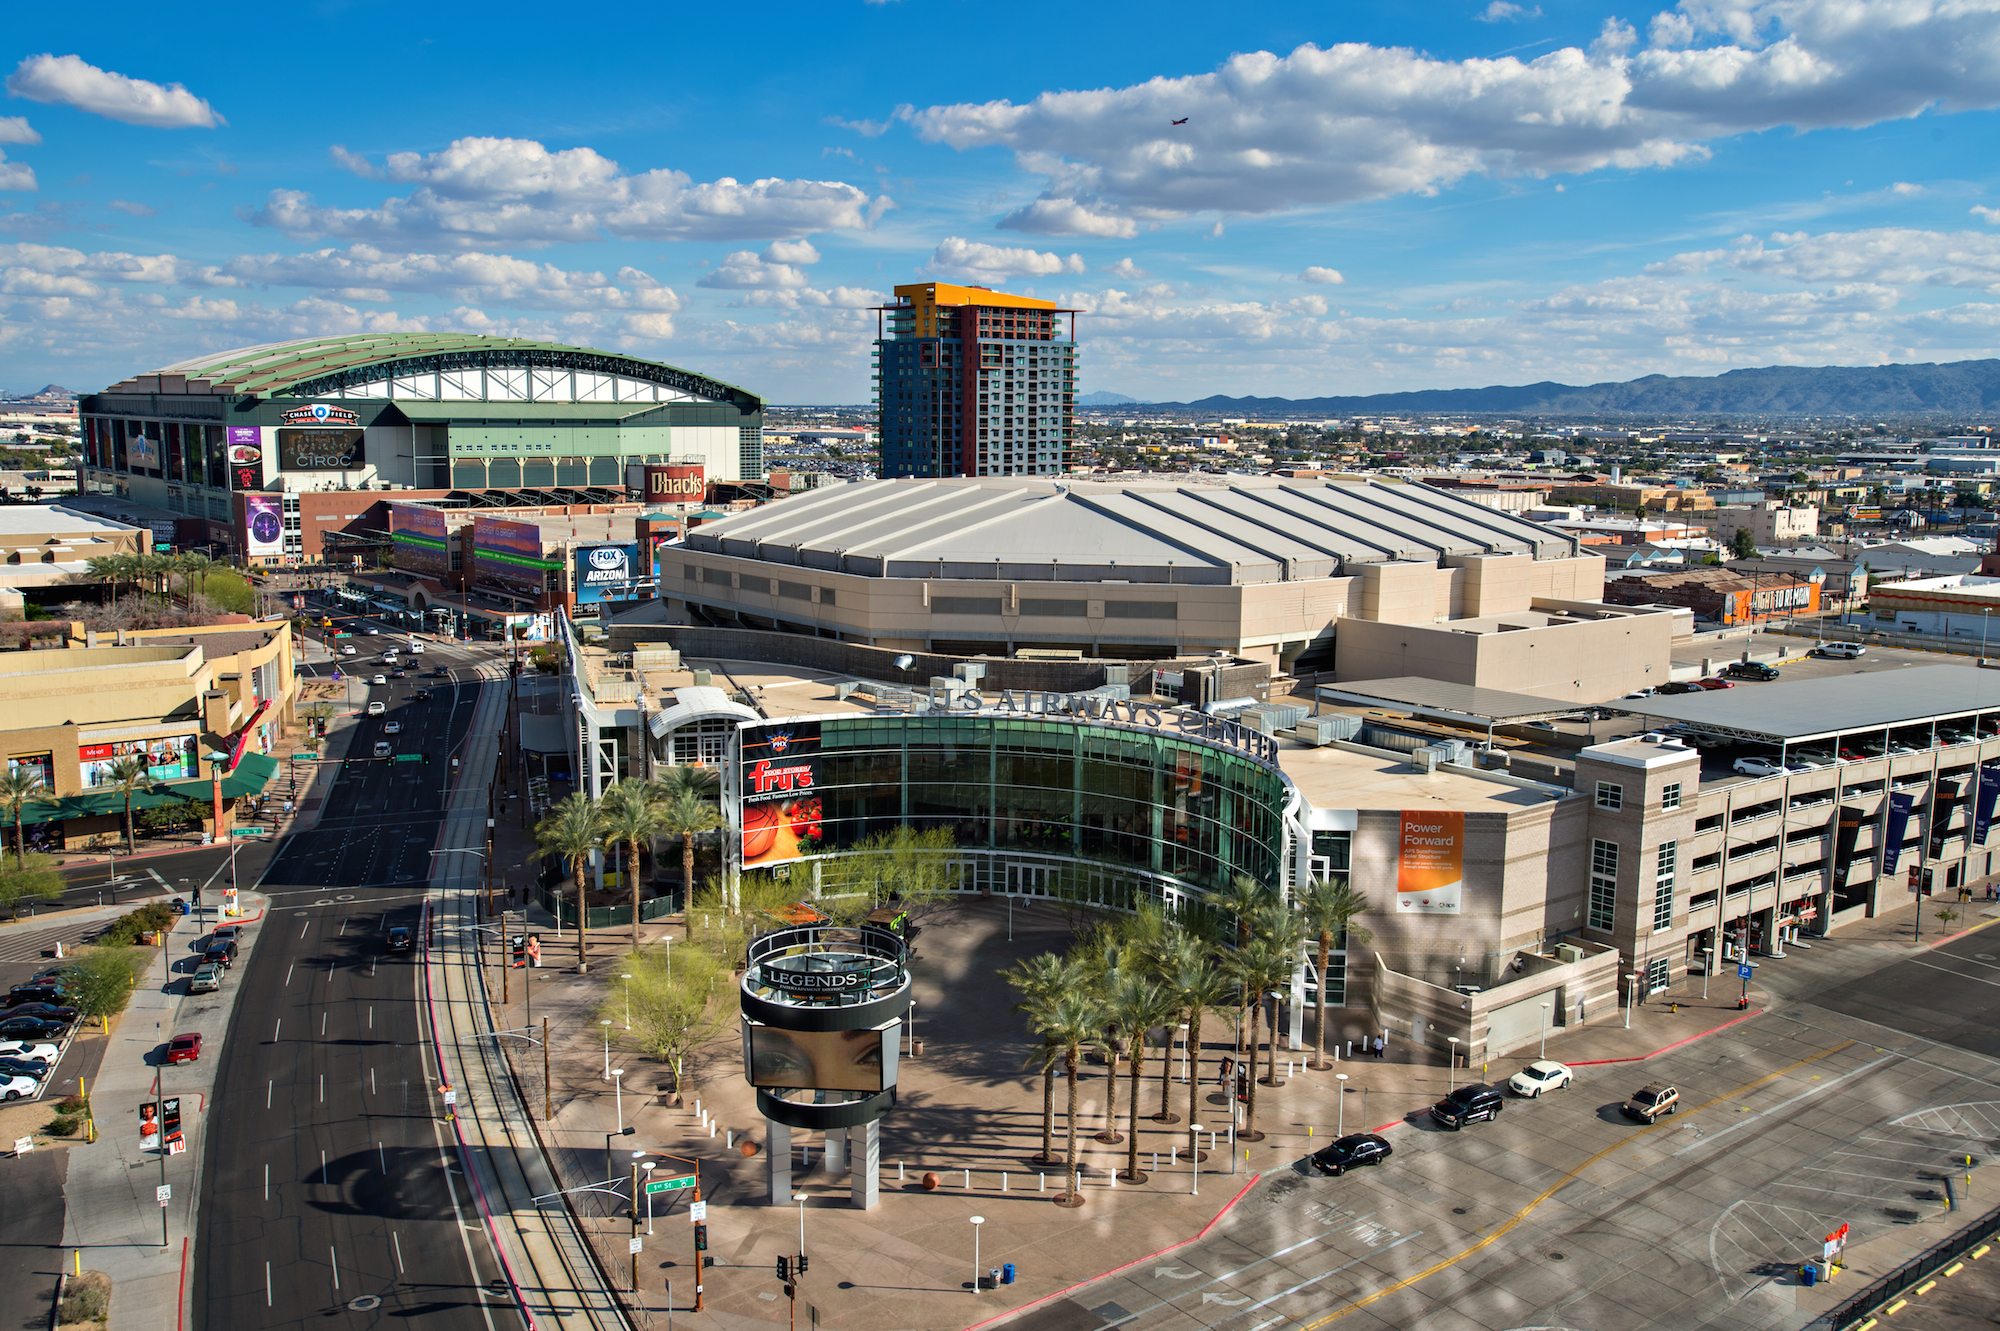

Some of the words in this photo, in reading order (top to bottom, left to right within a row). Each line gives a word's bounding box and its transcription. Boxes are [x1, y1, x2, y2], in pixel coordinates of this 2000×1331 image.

[289, 411, 312, 419] CHASE
[331, 411, 353, 419] FIELD
[597, 551, 617, 561] FOX
[1775, 589, 1785, 608] TO
[994, 688, 1163, 728] AIRWAYS
[772, 741, 787, 749] PHX
[763, 768, 782, 778] FOOD
[783, 765, 809, 775] STORES
[1405, 822, 1443, 834] Power
[1404, 834, 1454, 846] Forward
[770, 970, 858, 987] LEGENDS
[653, 1183, 663, 1191] 1st
